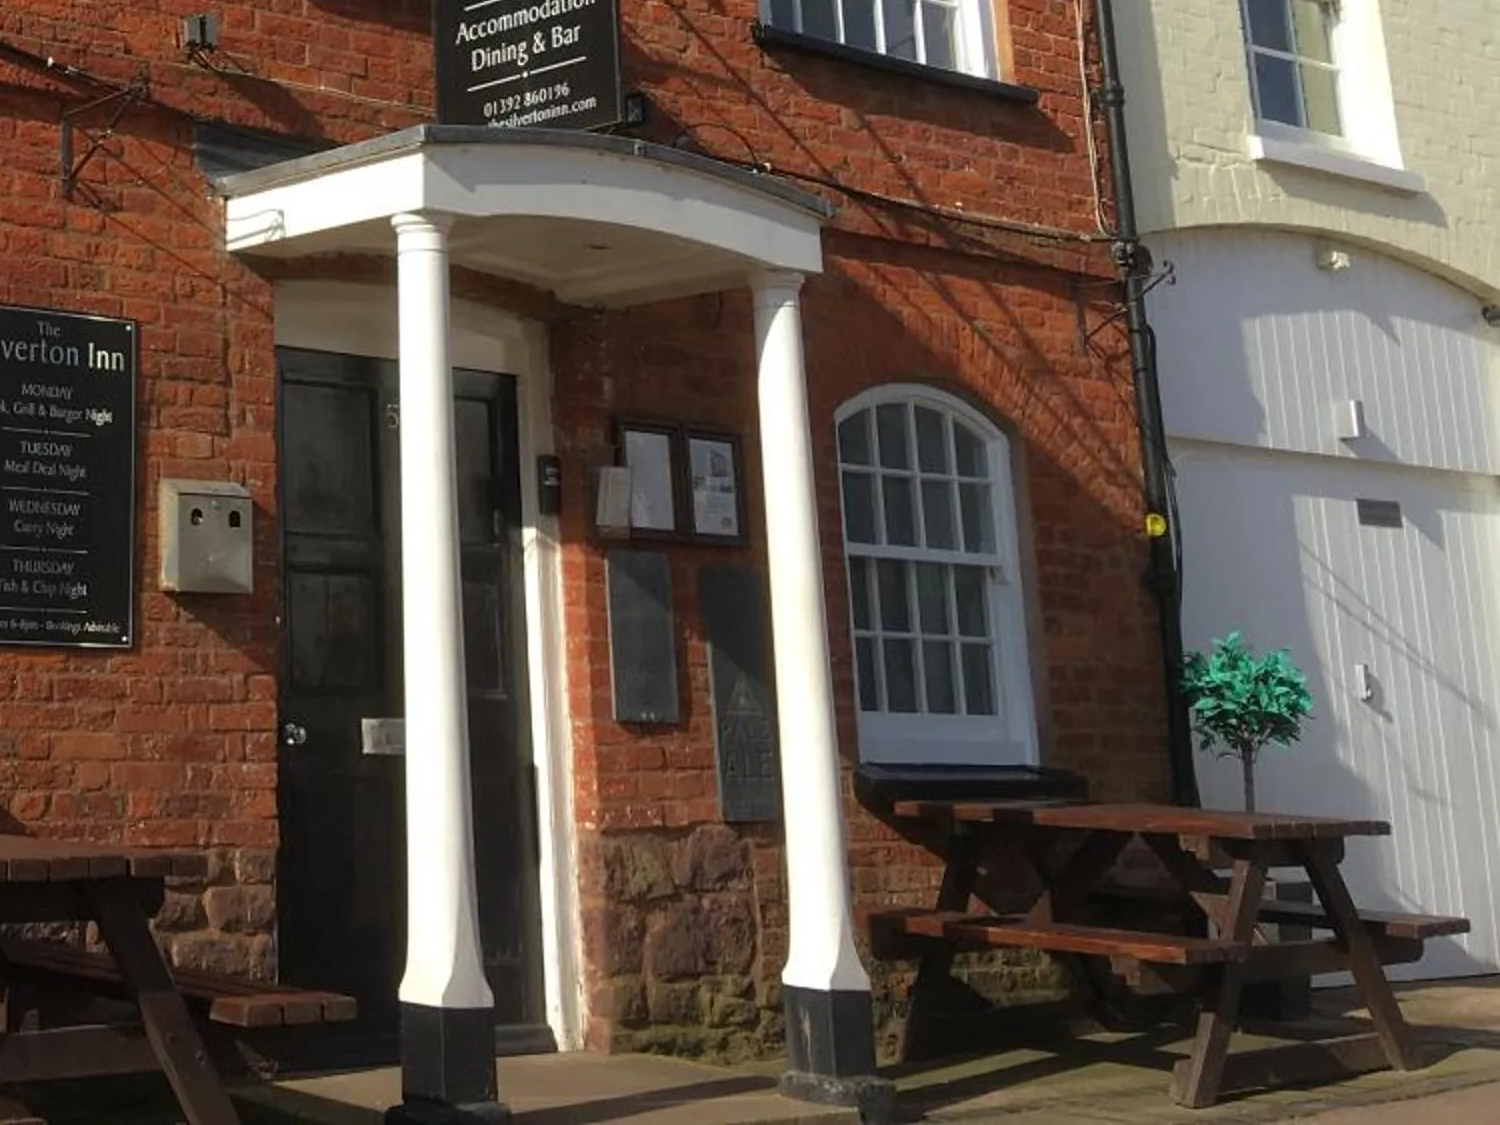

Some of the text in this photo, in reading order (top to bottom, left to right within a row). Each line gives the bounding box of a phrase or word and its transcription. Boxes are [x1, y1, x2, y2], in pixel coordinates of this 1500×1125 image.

[471, 24, 581, 72] Dining & Bar
[37, 321, 61, 336] The
[88, 342, 125, 372] Inn
[21, 383, 73, 401] MONDAY
[85, 408, 113, 427] Night
[20, 440, 73, 458] TUESDAY
[8, 498, 81, 517] WEDNESDAY
[12, 558, 75, 576] THURSDAY
